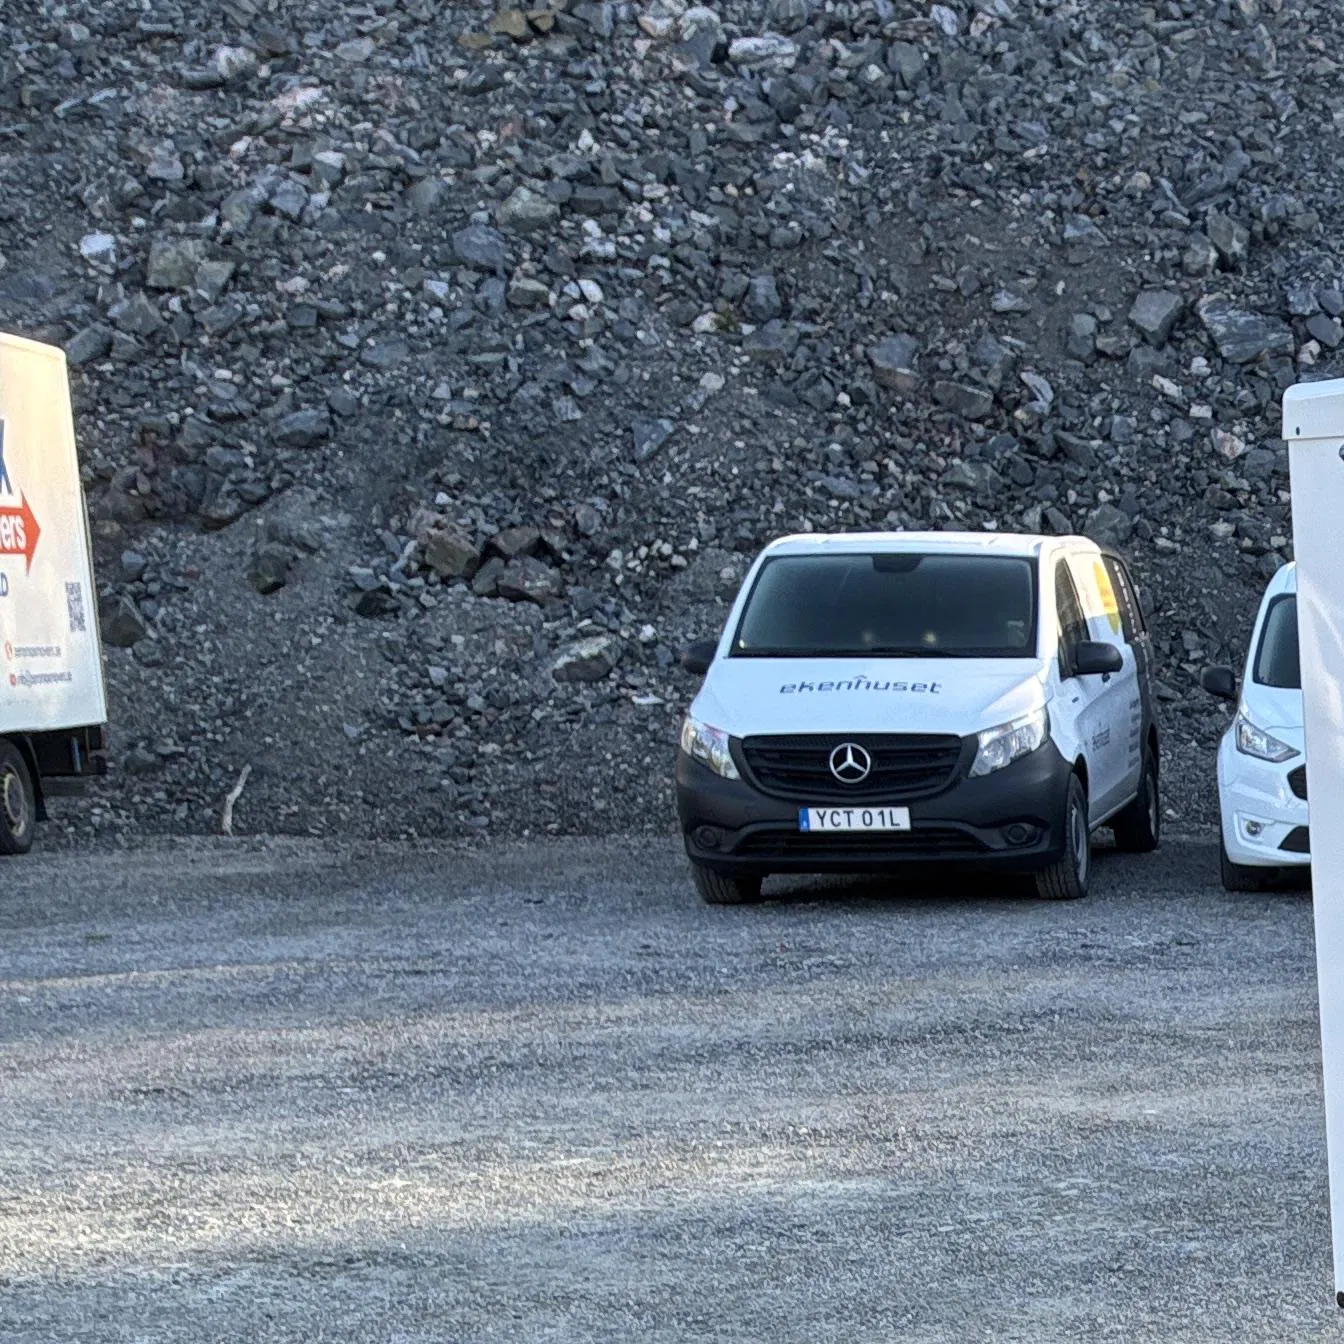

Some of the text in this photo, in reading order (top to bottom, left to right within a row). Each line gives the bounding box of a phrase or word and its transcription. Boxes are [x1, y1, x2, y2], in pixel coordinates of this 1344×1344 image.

[0, 514, 26, 549] ers
[780, 674, 942, 694] ekenhuset
[816, 809, 853, 827] YCT
